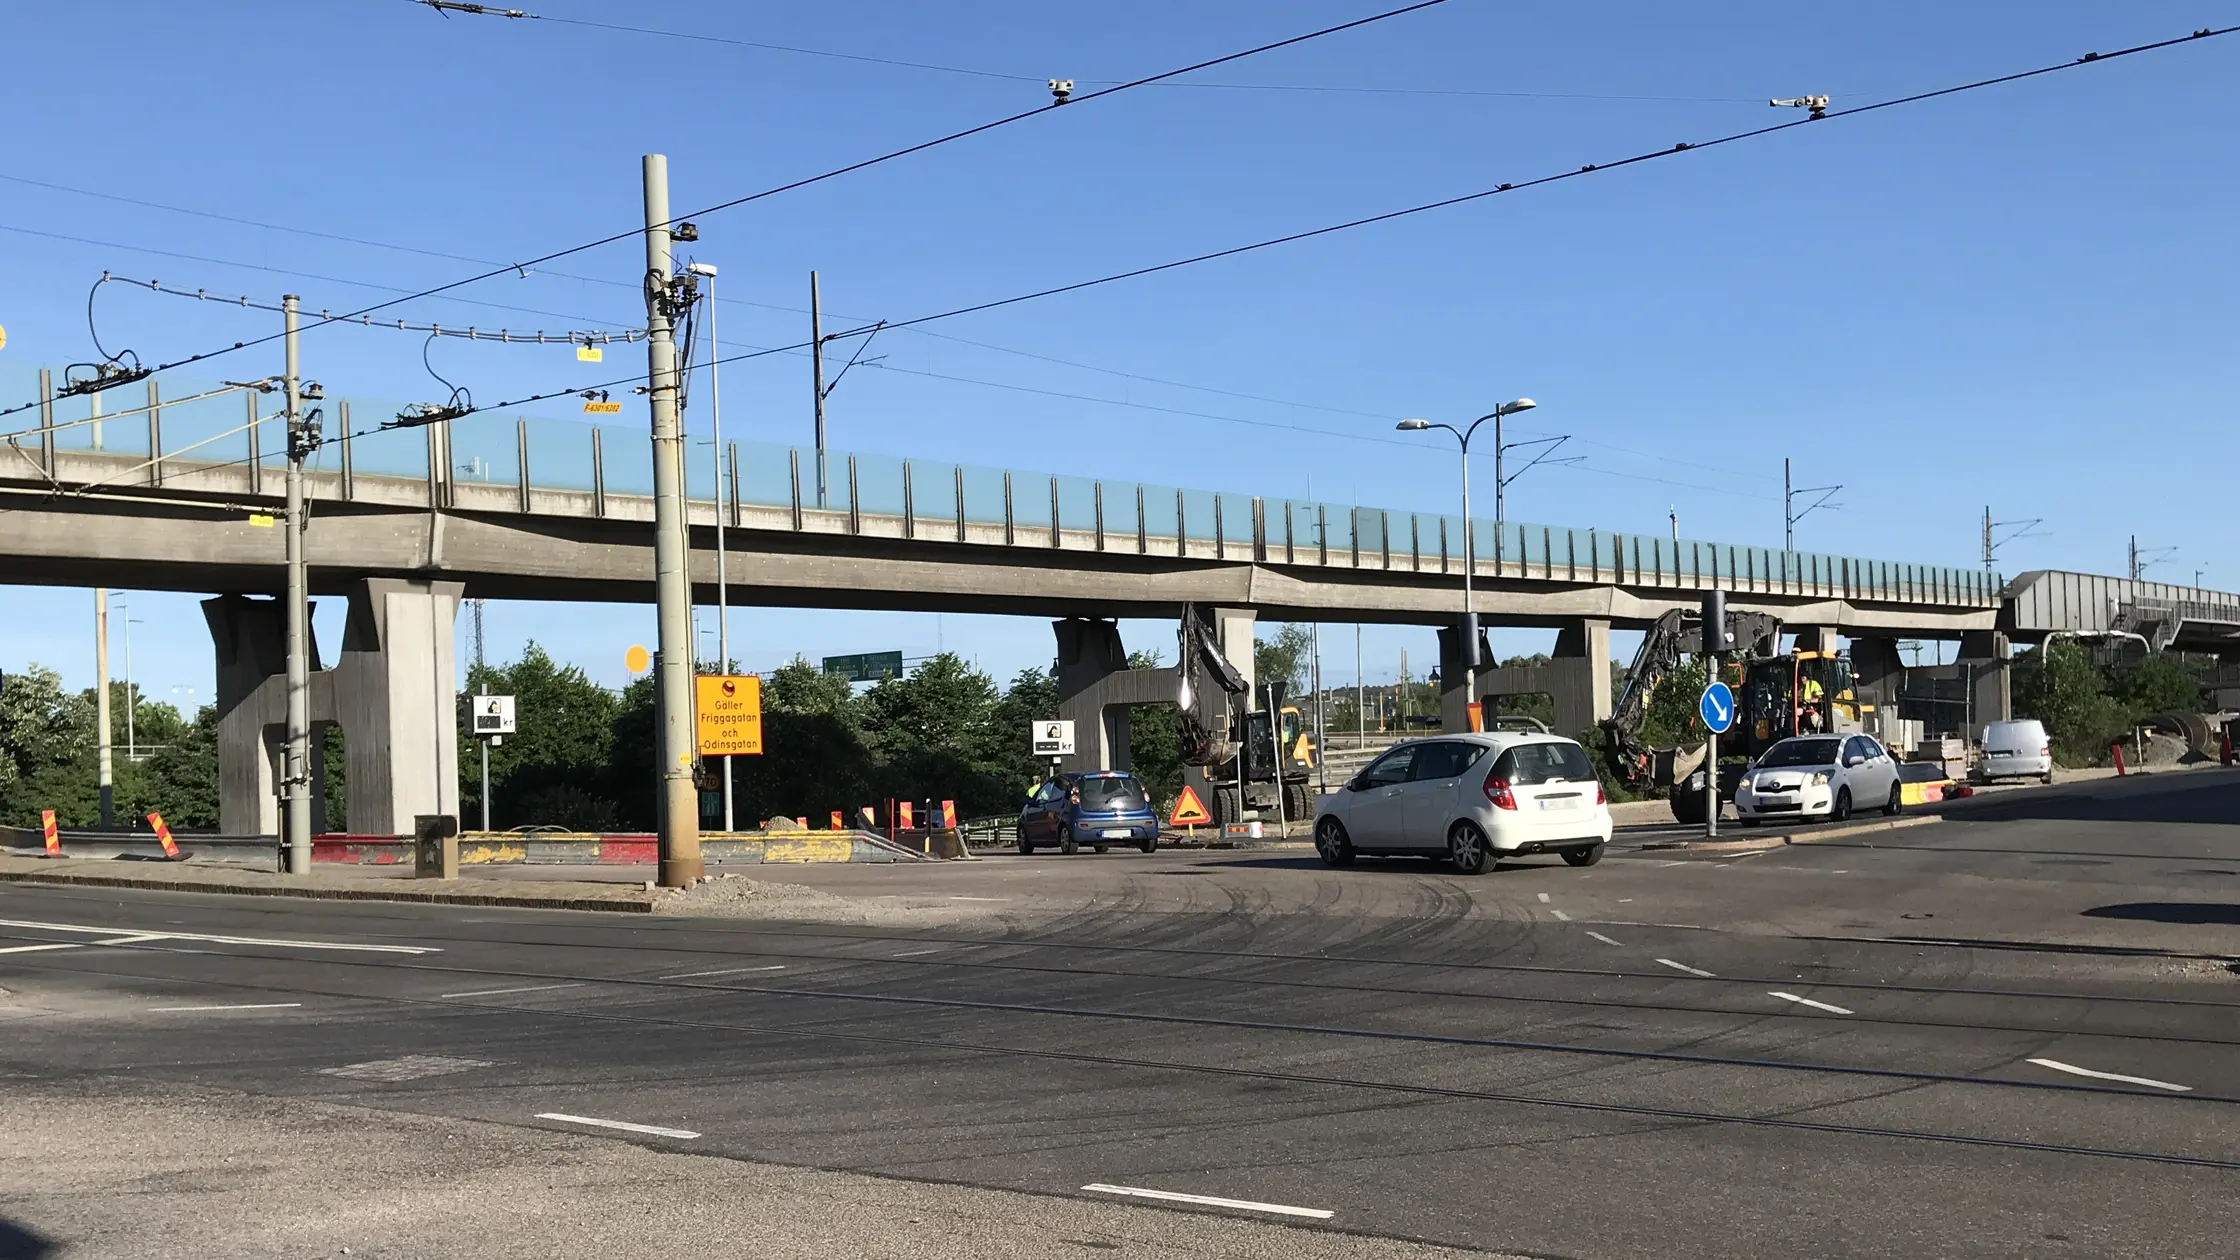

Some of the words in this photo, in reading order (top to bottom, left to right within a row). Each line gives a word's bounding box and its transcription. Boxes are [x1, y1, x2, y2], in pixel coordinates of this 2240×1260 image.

[715, 700, 743, 710] Gäller
[503, 718, 513, 727] kr
[701, 713, 757, 725] Friggagatan
[722, 728, 738, 738] och
[704, 740, 757, 751] Odinsgatan
[1062, 742, 1072, 751] kr
